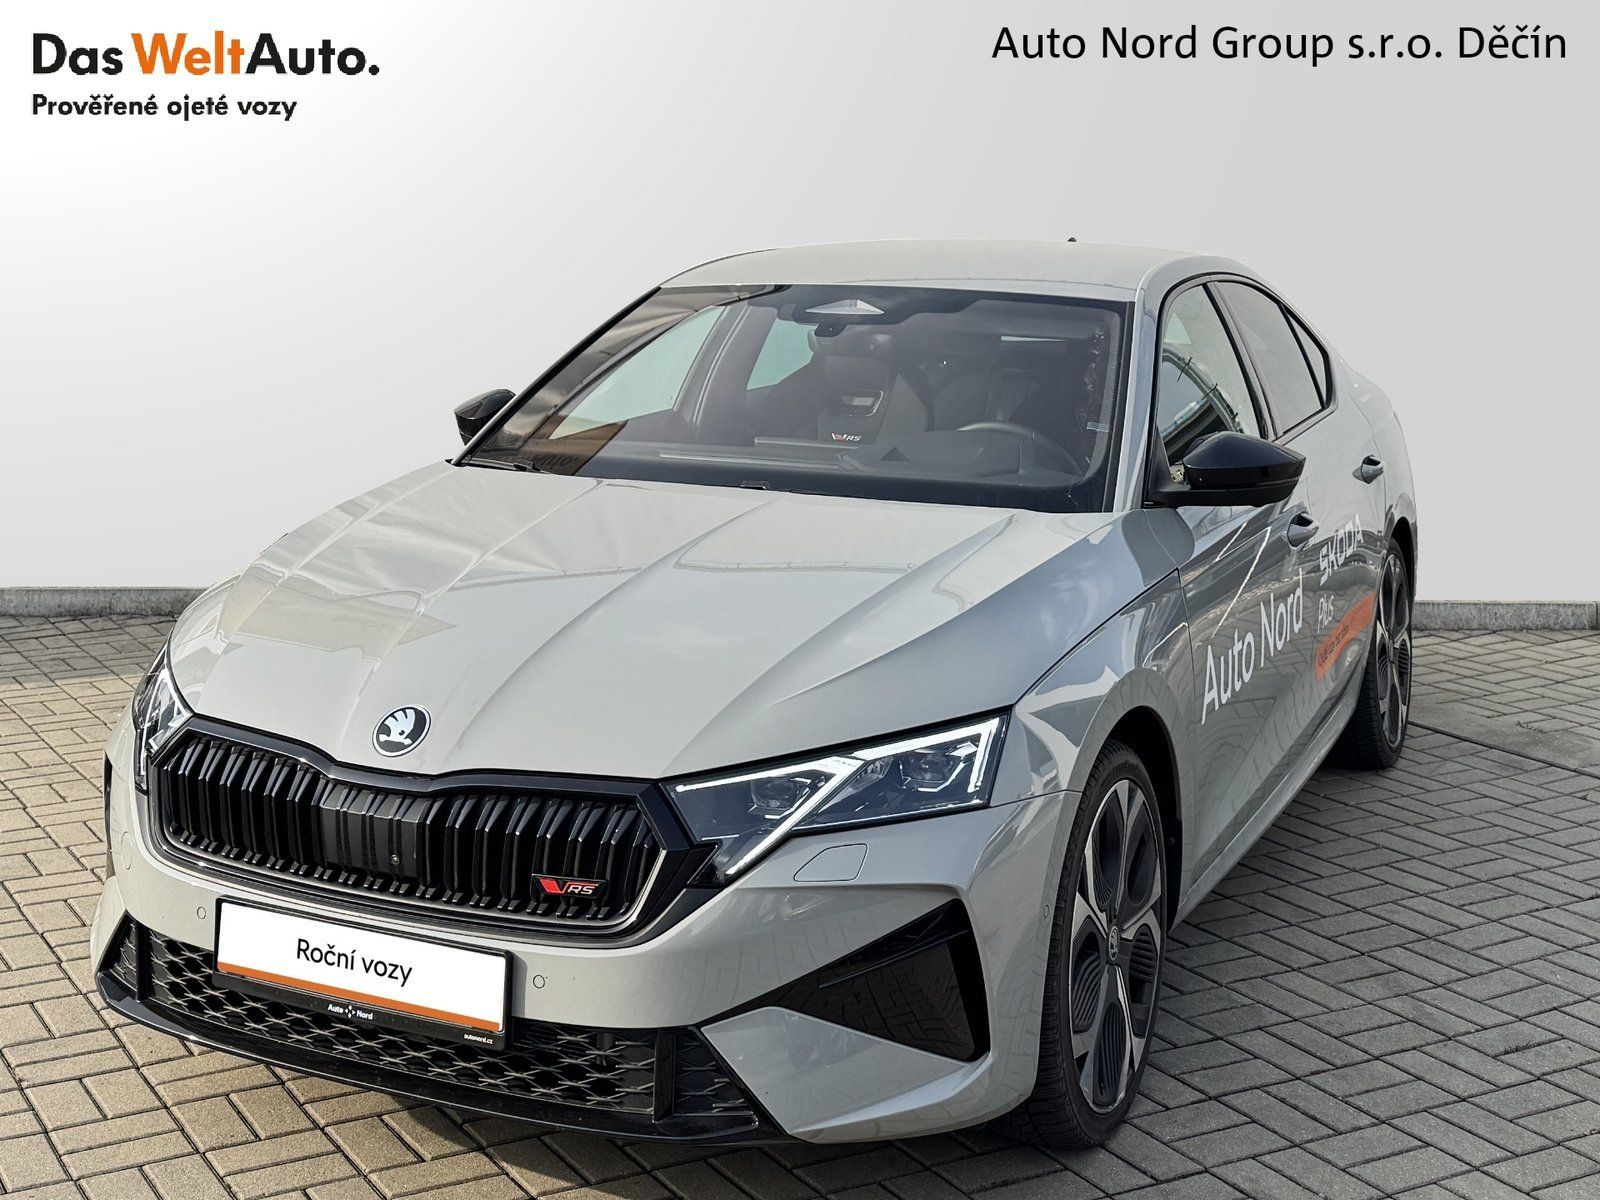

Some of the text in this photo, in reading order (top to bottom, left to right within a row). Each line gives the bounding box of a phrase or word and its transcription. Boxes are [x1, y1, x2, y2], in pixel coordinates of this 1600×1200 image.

[1201, 567, 1304, 725] Auto Nord
[297, 938, 413, 988] Roční vozy
[327, 1003, 374, 1020] Auto Nord
